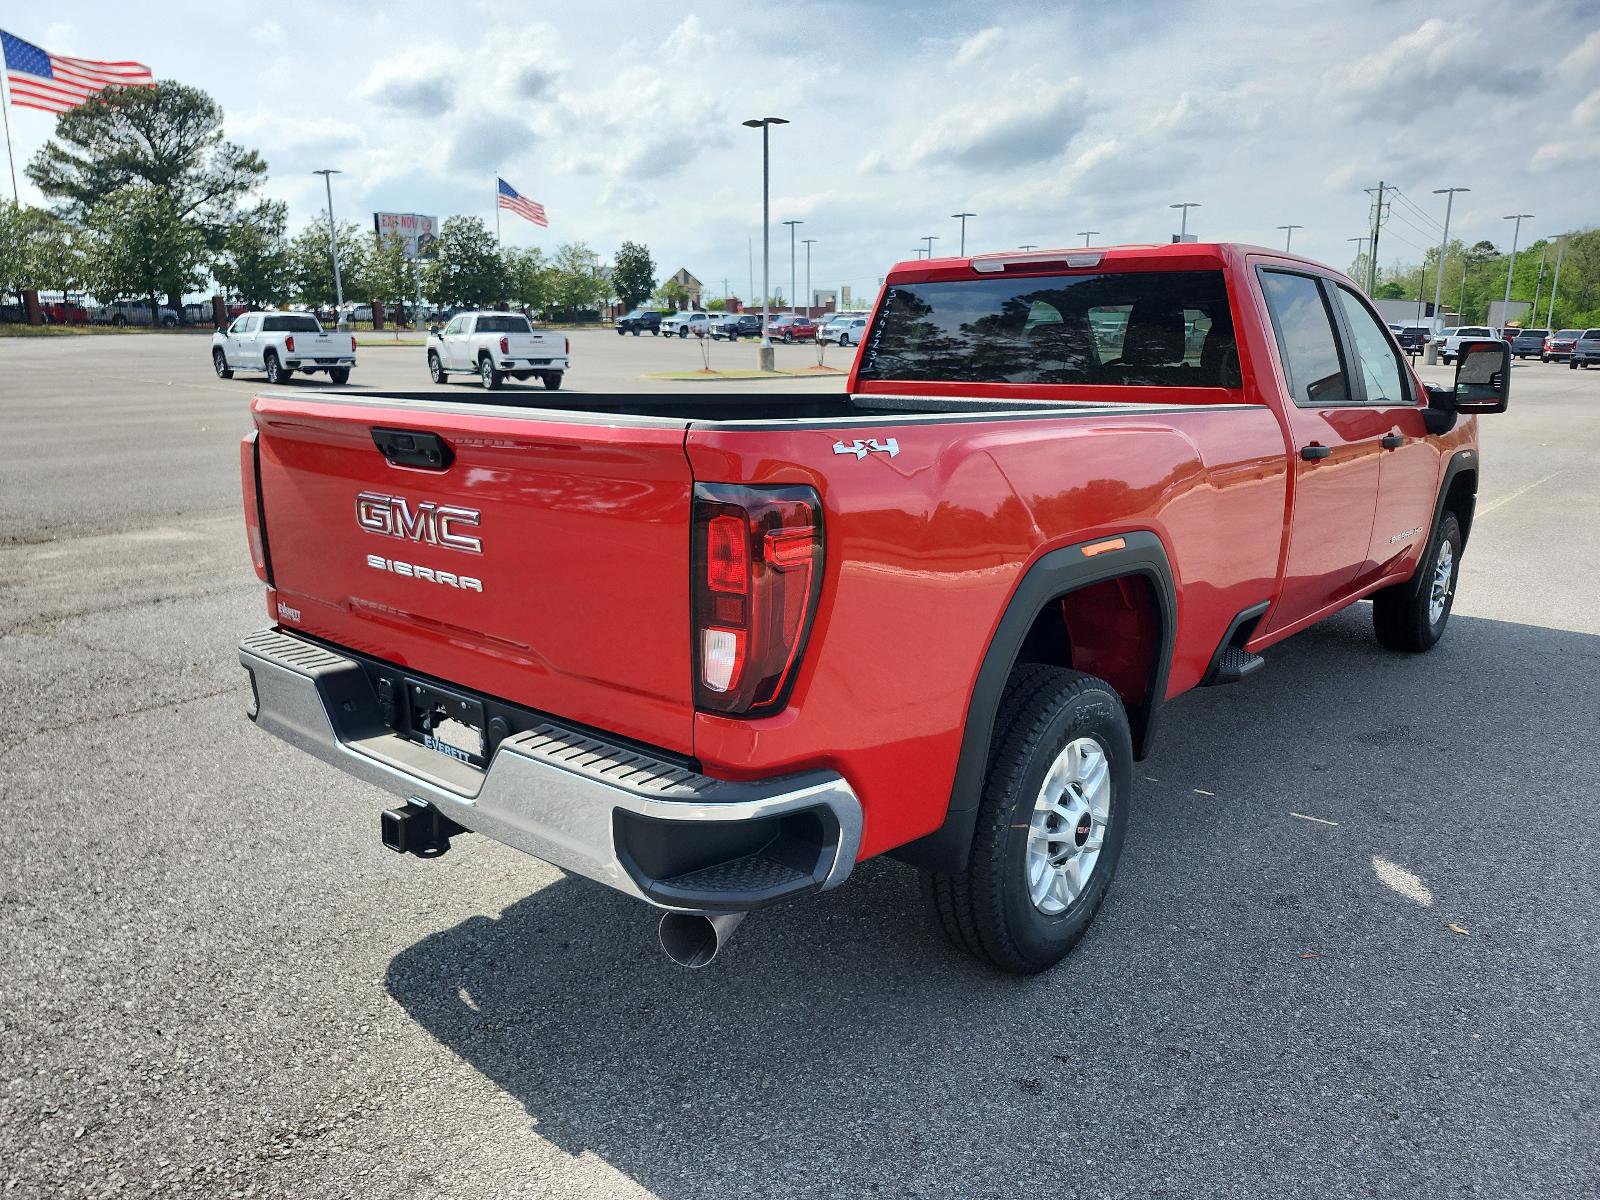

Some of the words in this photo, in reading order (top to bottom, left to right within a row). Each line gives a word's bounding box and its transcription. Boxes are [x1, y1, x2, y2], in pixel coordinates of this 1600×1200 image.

[356, 490, 483, 555] GMC
[367, 554, 483, 592] SIERRA
[424, 735, 470, 762] EVERETT
